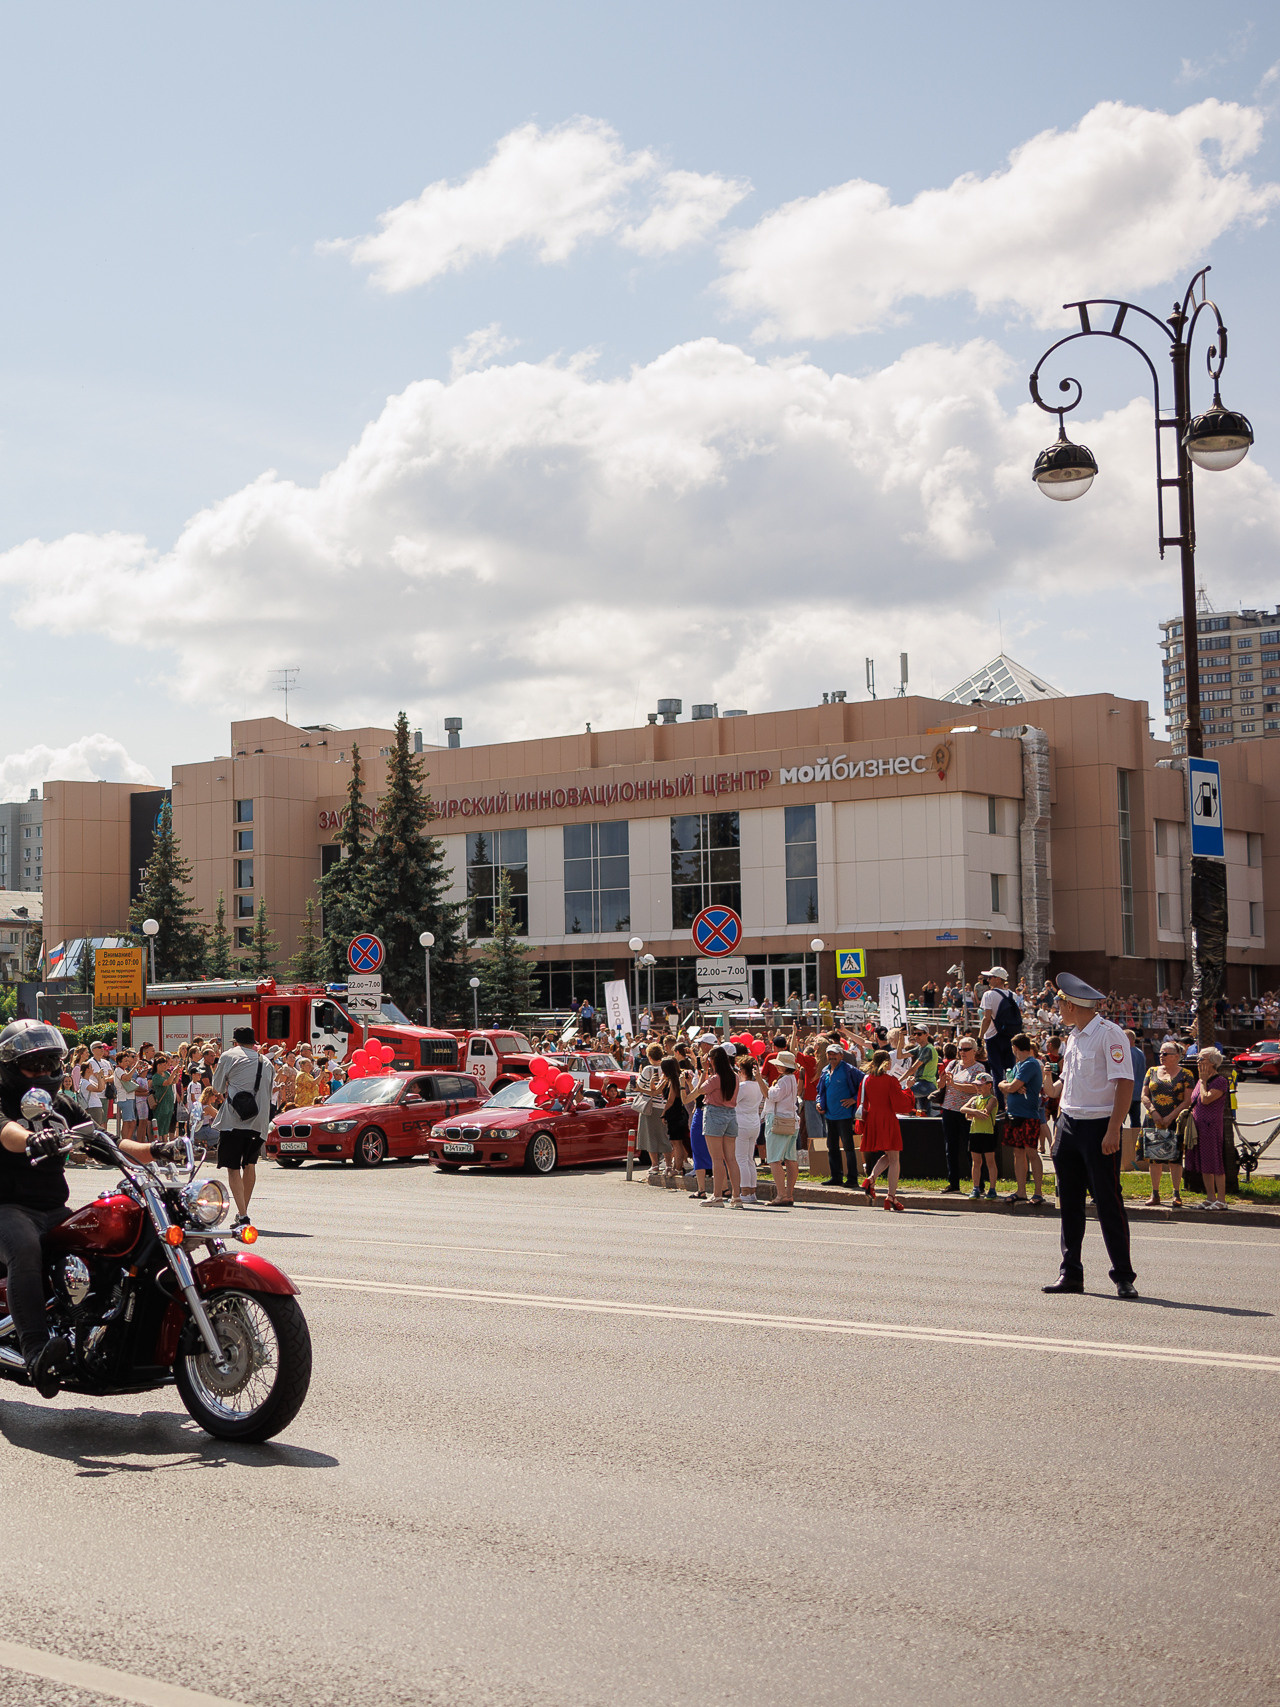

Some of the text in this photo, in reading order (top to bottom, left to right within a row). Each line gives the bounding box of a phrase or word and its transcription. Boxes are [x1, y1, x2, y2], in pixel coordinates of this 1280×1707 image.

[780, 754, 926, 785] мойбизнес
[515, 772, 695, 812] ИННОВАЦИОННЫЙ
[702, 769, 771, 797] ЦЕНТР
[473, 1064, 486, 1076] 53
